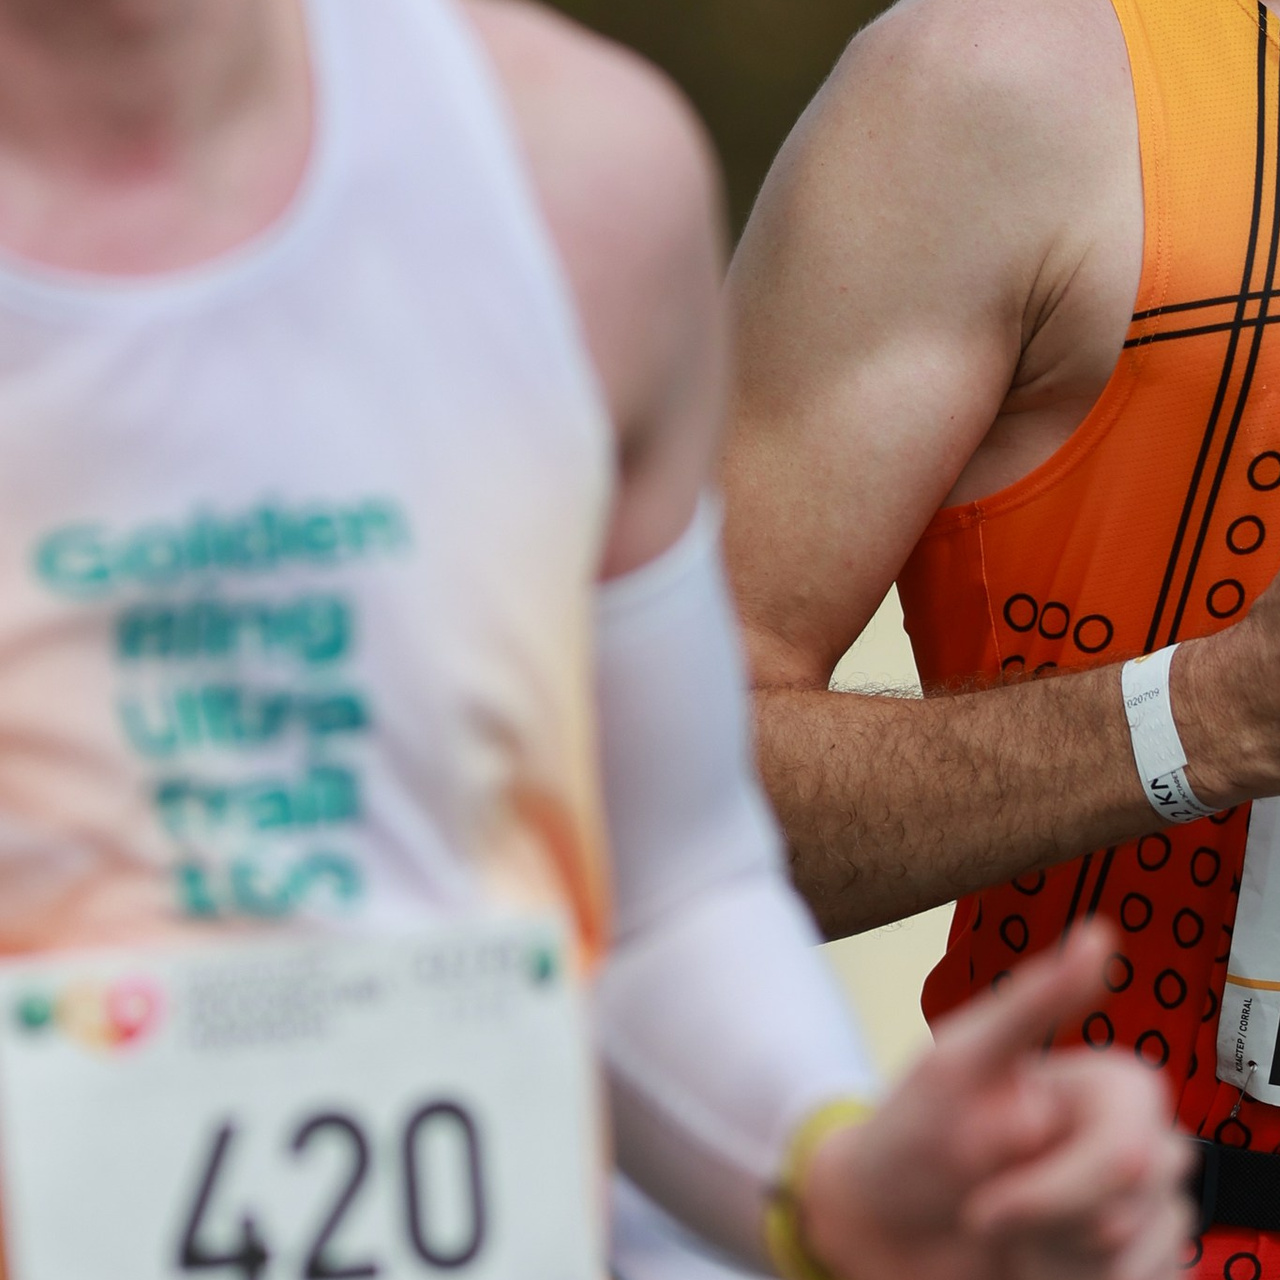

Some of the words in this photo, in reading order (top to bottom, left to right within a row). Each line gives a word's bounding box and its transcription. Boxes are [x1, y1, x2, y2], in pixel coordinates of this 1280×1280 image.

[35, 495, 412, 598] Golden
[1239, 998, 1253, 1032] CORRAL
[1235, 1039, 1246, 1073] КЛАСТЕР
